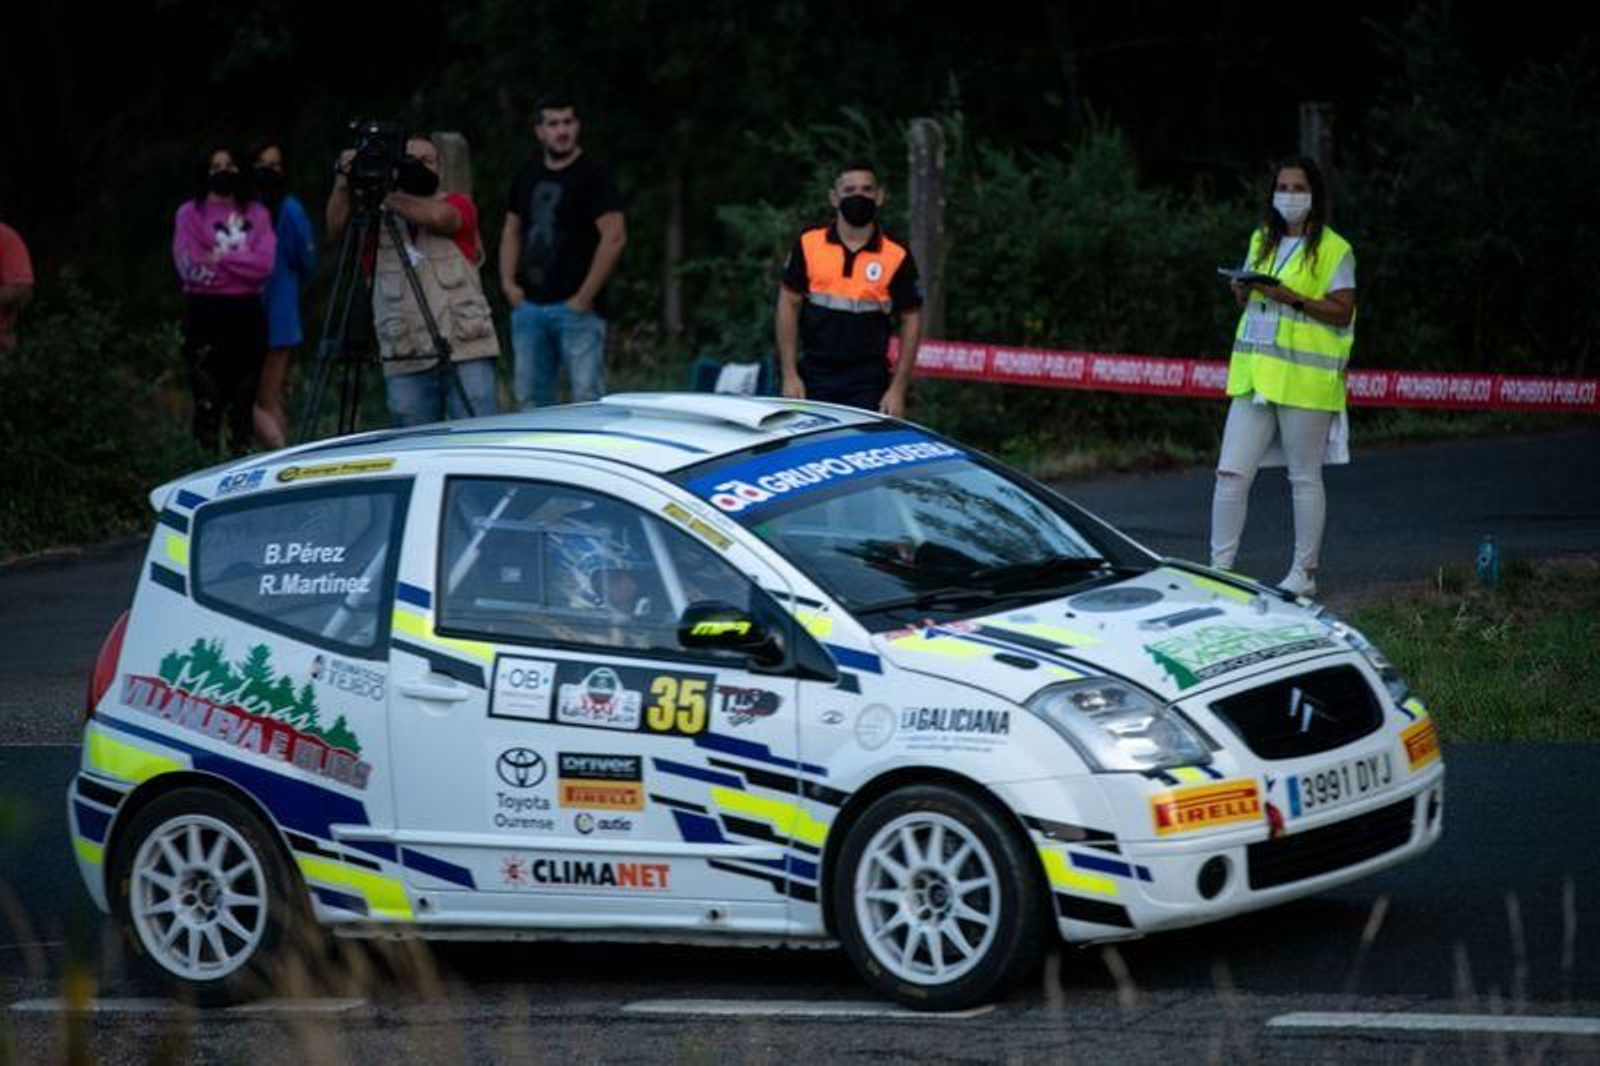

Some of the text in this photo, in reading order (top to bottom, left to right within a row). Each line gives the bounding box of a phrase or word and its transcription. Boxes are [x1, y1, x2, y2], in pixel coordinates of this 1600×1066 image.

[757, 458, 852, 493] GRUPO
[844, 440, 964, 472] REGUEIRA
[264, 542, 346, 565] B.Pérez
[173, 661, 315, 730] Maderas
[647, 675, 706, 735] 35
[916, 707, 1010, 736] GALICIANA
[1301, 753, 1394, 808] 3991 DYJ
[496, 793, 550, 812] Toyota
[1155, 786, 1260, 829] PIRELLI
[494, 813, 554, 831] Ourense
[532, 858, 671, 889] CLIMANET
